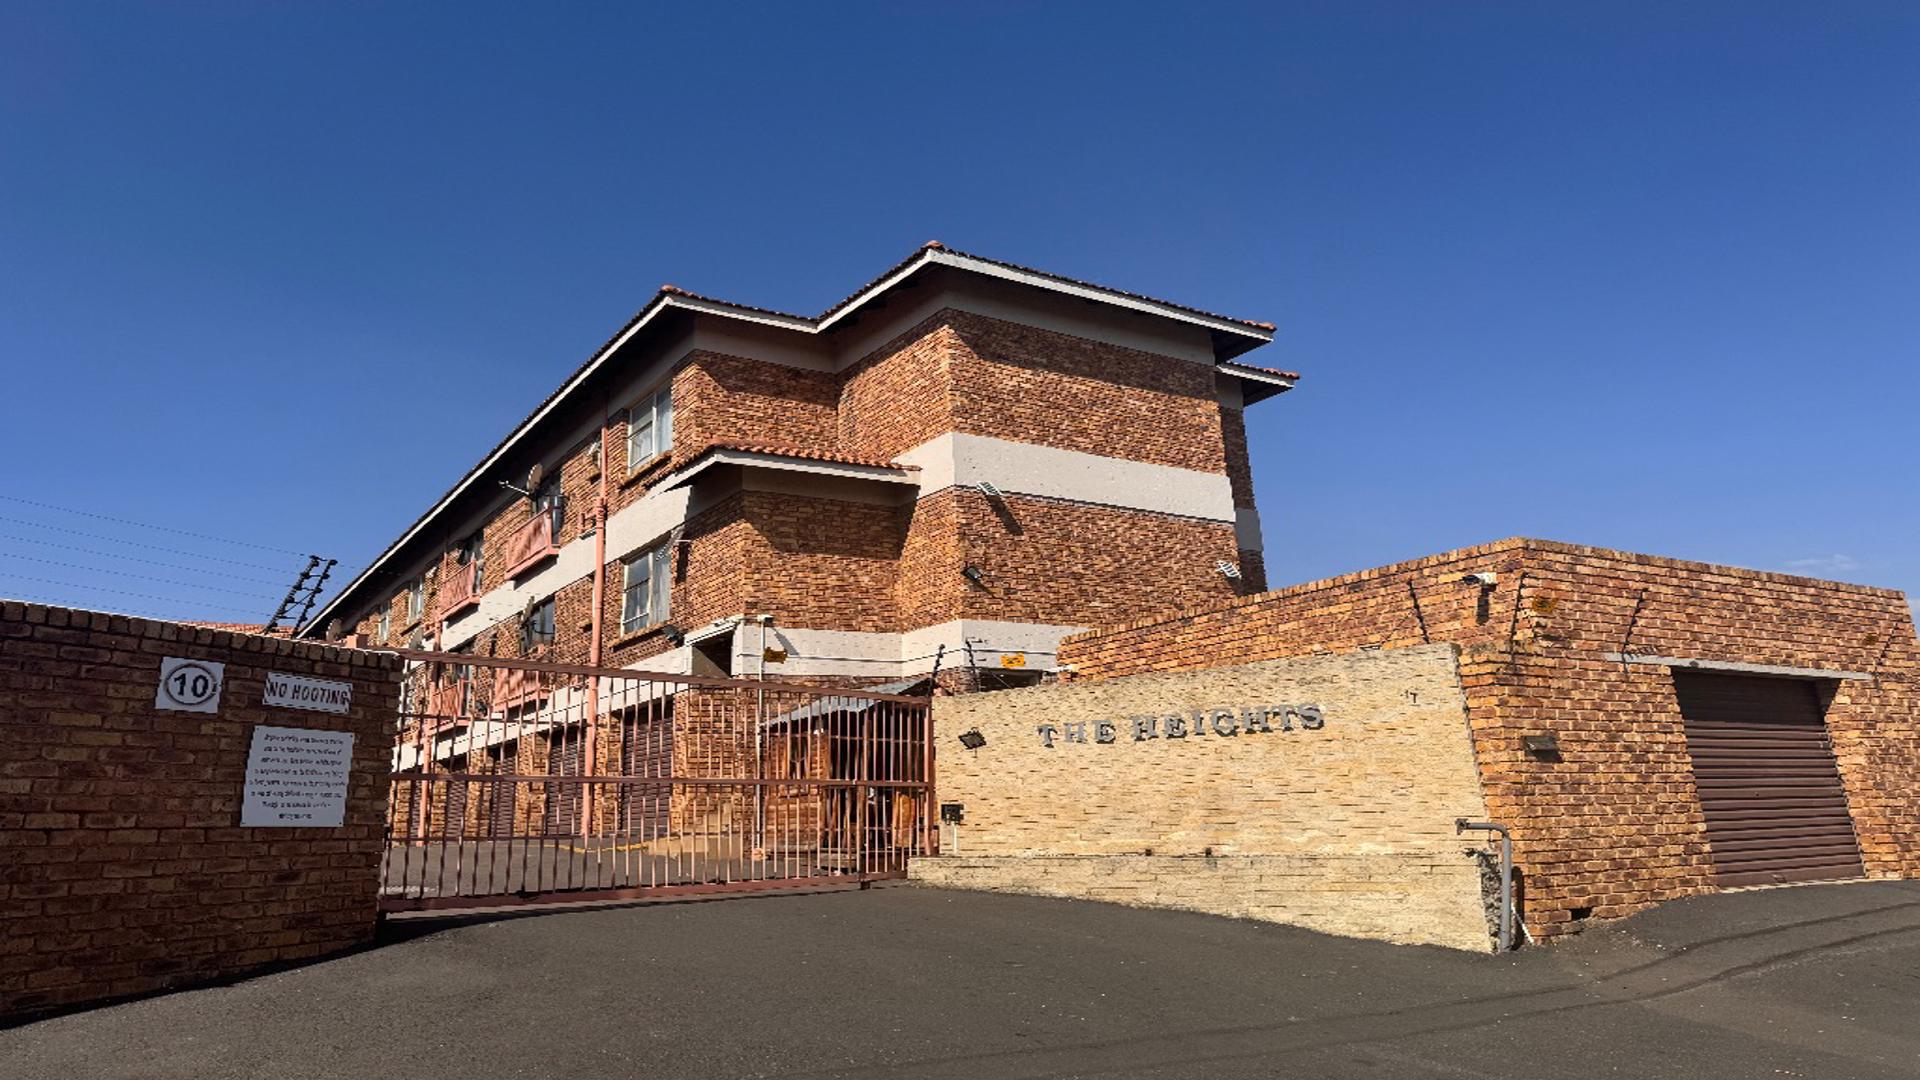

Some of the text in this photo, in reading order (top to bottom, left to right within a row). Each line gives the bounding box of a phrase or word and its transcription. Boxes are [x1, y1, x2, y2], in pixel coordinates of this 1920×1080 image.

[173, 673, 209, 698] 10
[267, 681, 347, 705] NO HOOTING
[1037, 703, 1324, 748] THE HEIGHTS
